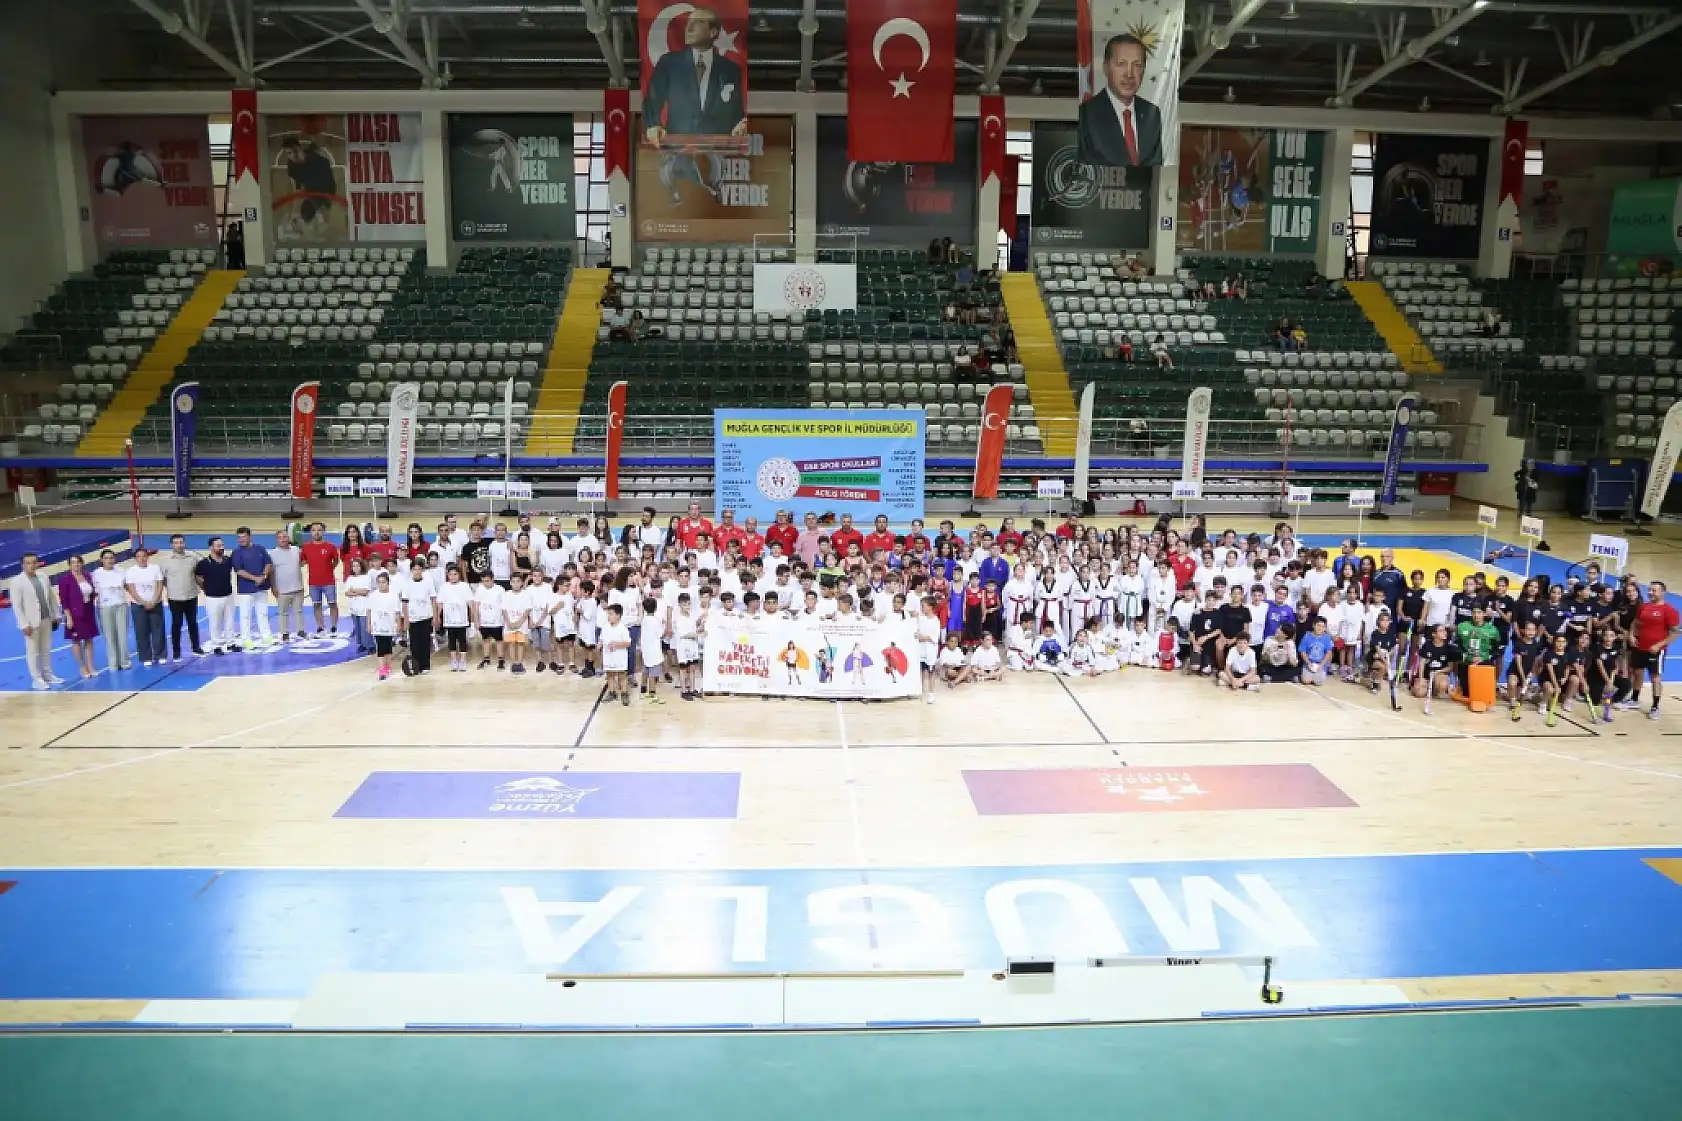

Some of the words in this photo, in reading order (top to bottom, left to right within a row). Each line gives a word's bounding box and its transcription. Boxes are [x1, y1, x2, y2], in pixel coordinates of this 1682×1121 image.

[517, 136, 559, 158] SPOR
[519, 160, 548, 181] HER
[1437, 153, 1477, 177] SPOR
[520, 183, 567, 204] YERDE
[720, 184, 768, 206] YERDE
[727, 422, 759, 433] MUĞLA
[761, 422, 801, 434] GENÇLİK
[804, 424, 815, 433] VE
[817, 424, 843, 433] SPOR
